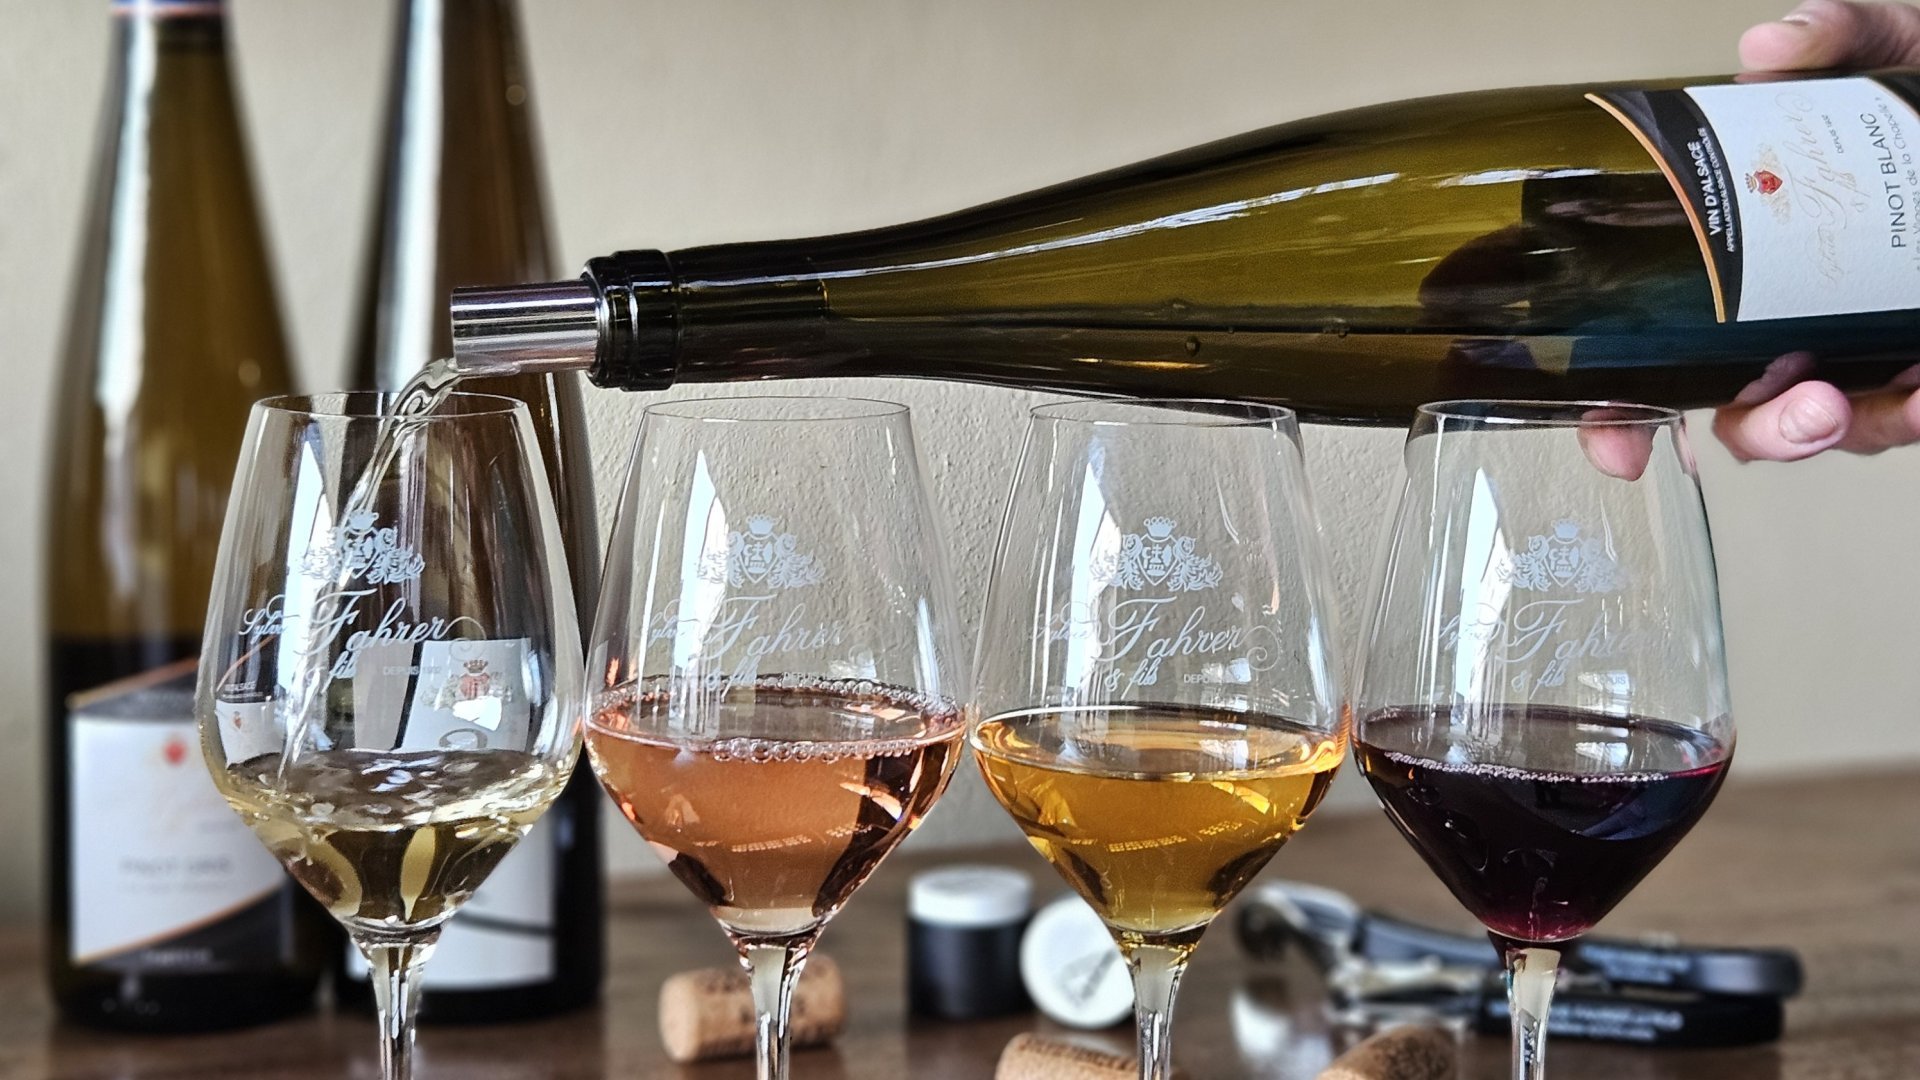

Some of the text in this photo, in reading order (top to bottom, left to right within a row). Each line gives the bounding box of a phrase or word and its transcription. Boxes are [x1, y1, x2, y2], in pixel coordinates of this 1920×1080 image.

[1687, 141, 1721, 235] VIN D'ALSACE
[1776, 98, 1847, 229] Fahrer
[1860, 112, 1908, 248] PINOT BLANC
[1902, 153, 1912, 166] la
[1905, 169, 1918, 186] de
[1720, 199, 1735, 252] APPELLATION
[293, 588, 487, 656] Fahrer
[703, 594, 852, 660] Fahrer
[1092, 596, 1278, 665] Fahrer
[1104, 655, 1160, 700] & fils
